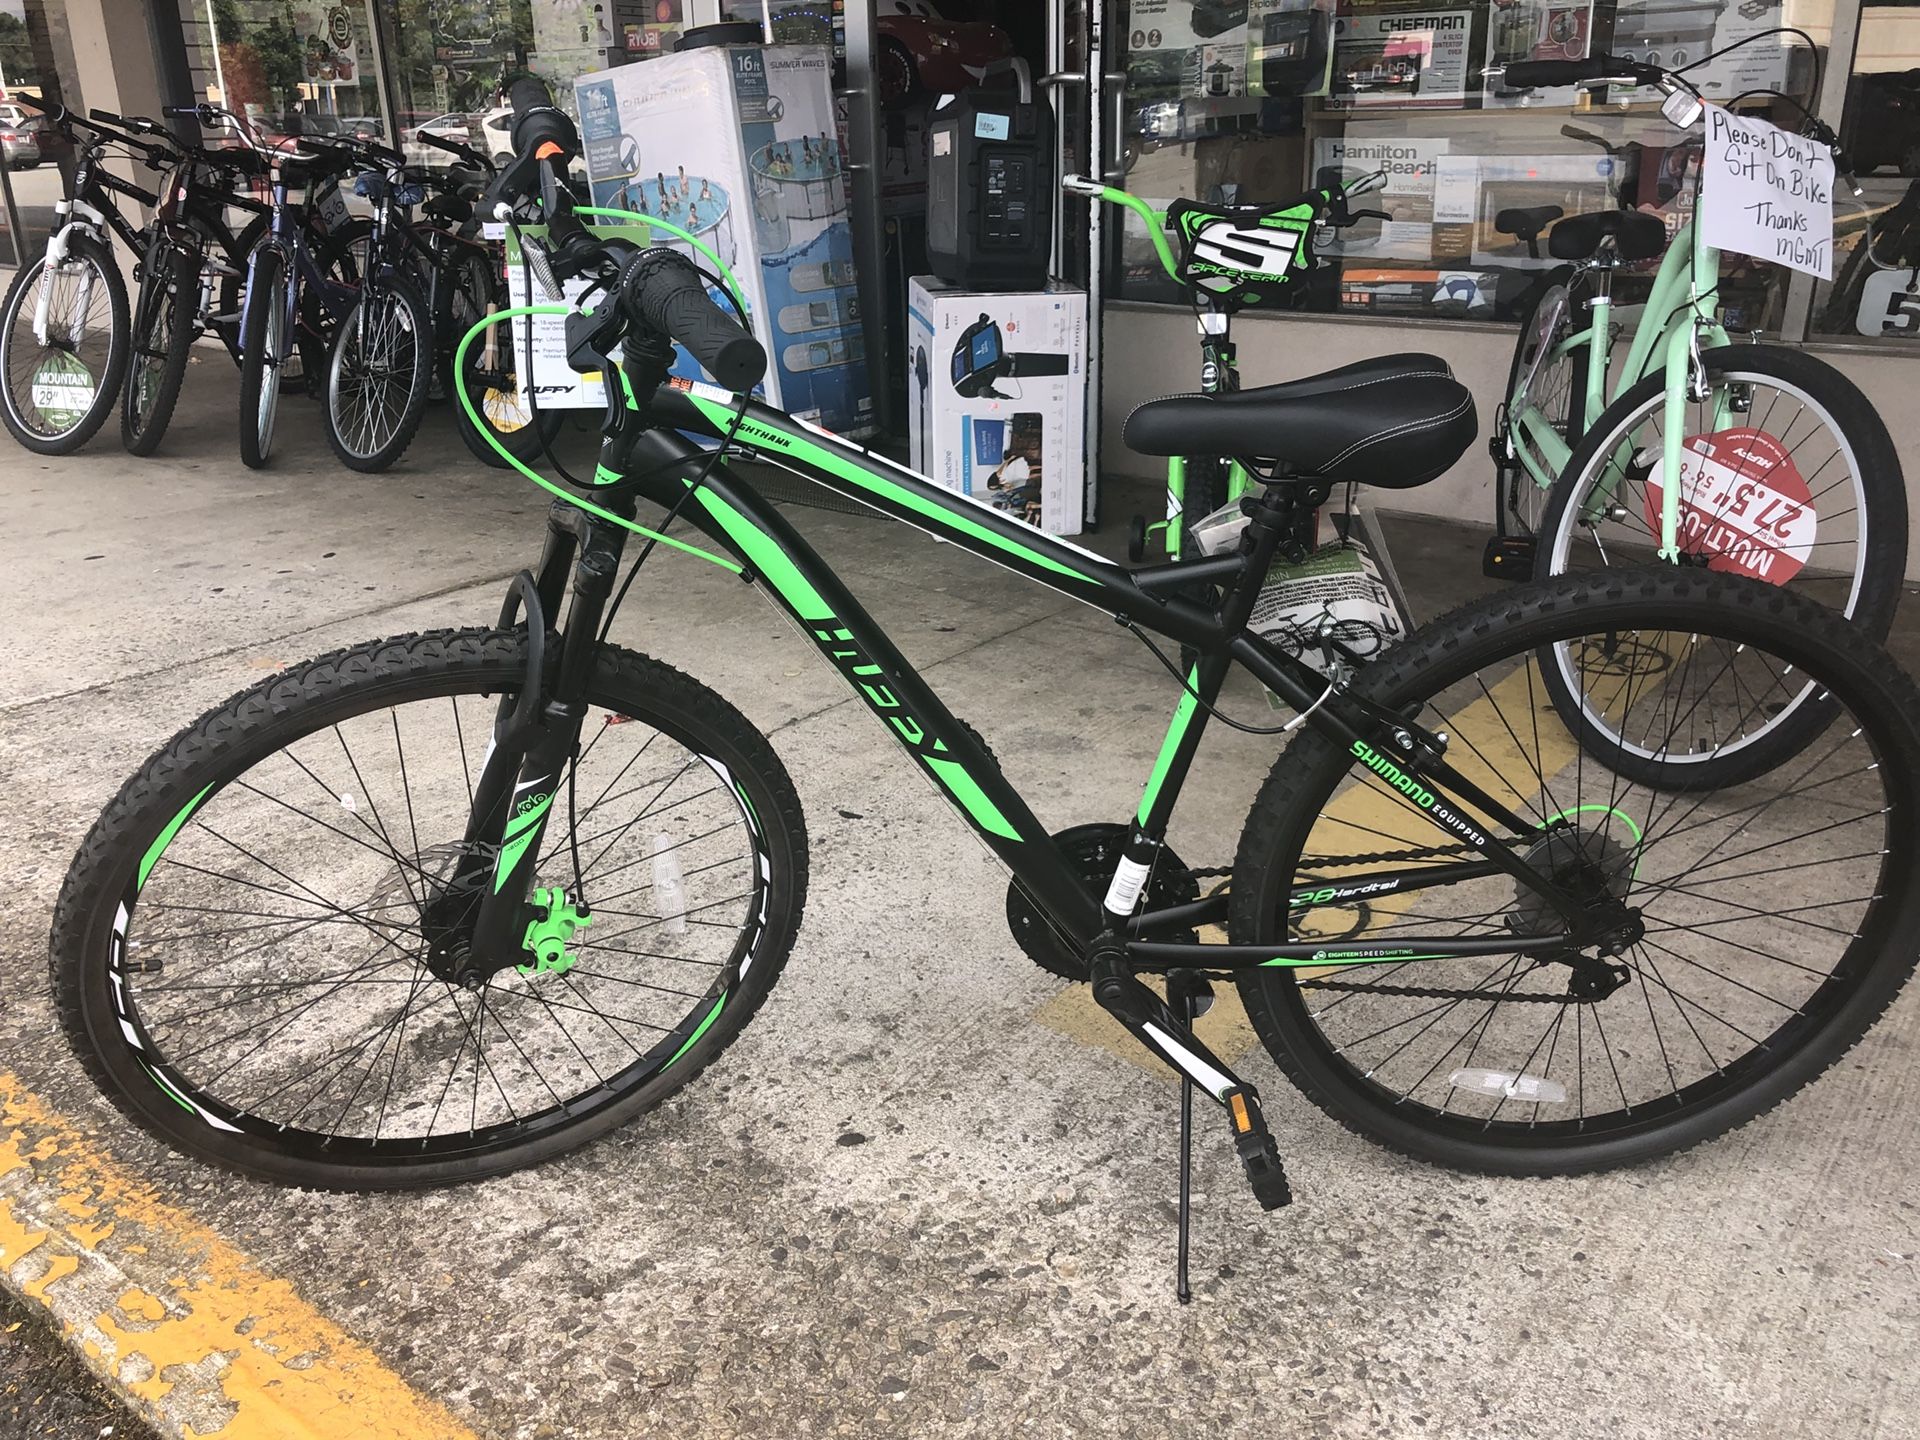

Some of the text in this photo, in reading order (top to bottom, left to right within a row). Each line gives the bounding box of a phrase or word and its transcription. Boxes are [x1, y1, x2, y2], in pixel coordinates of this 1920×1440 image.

[1379, 15, 1465, 32] CHEFMAN
[627, 32, 658, 48] RYOBI
[737, 55, 761, 72] 16 ft
[769, 59, 826, 70] SUMMER WAVES
[1713, 111, 1825, 170] Please Don't
[1332, 144, 1418, 160] Hamilton
[1380, 159, 1437, 176] Beach
[1723, 143, 1828, 204] Sit On Bike
[1744, 201, 1808, 232] Thanks
[1191, 262, 1239, 278] RACE
[39, 371, 89, 387] MOUNTAIN
[1732, 447, 1774, 469] HUFFY
[1658, 504, 1776, 577] MULTI-US
[1349, 739, 1486, 847] SHIMANO EQUIPPED
[1331, 878, 1400, 899] Hardtail
